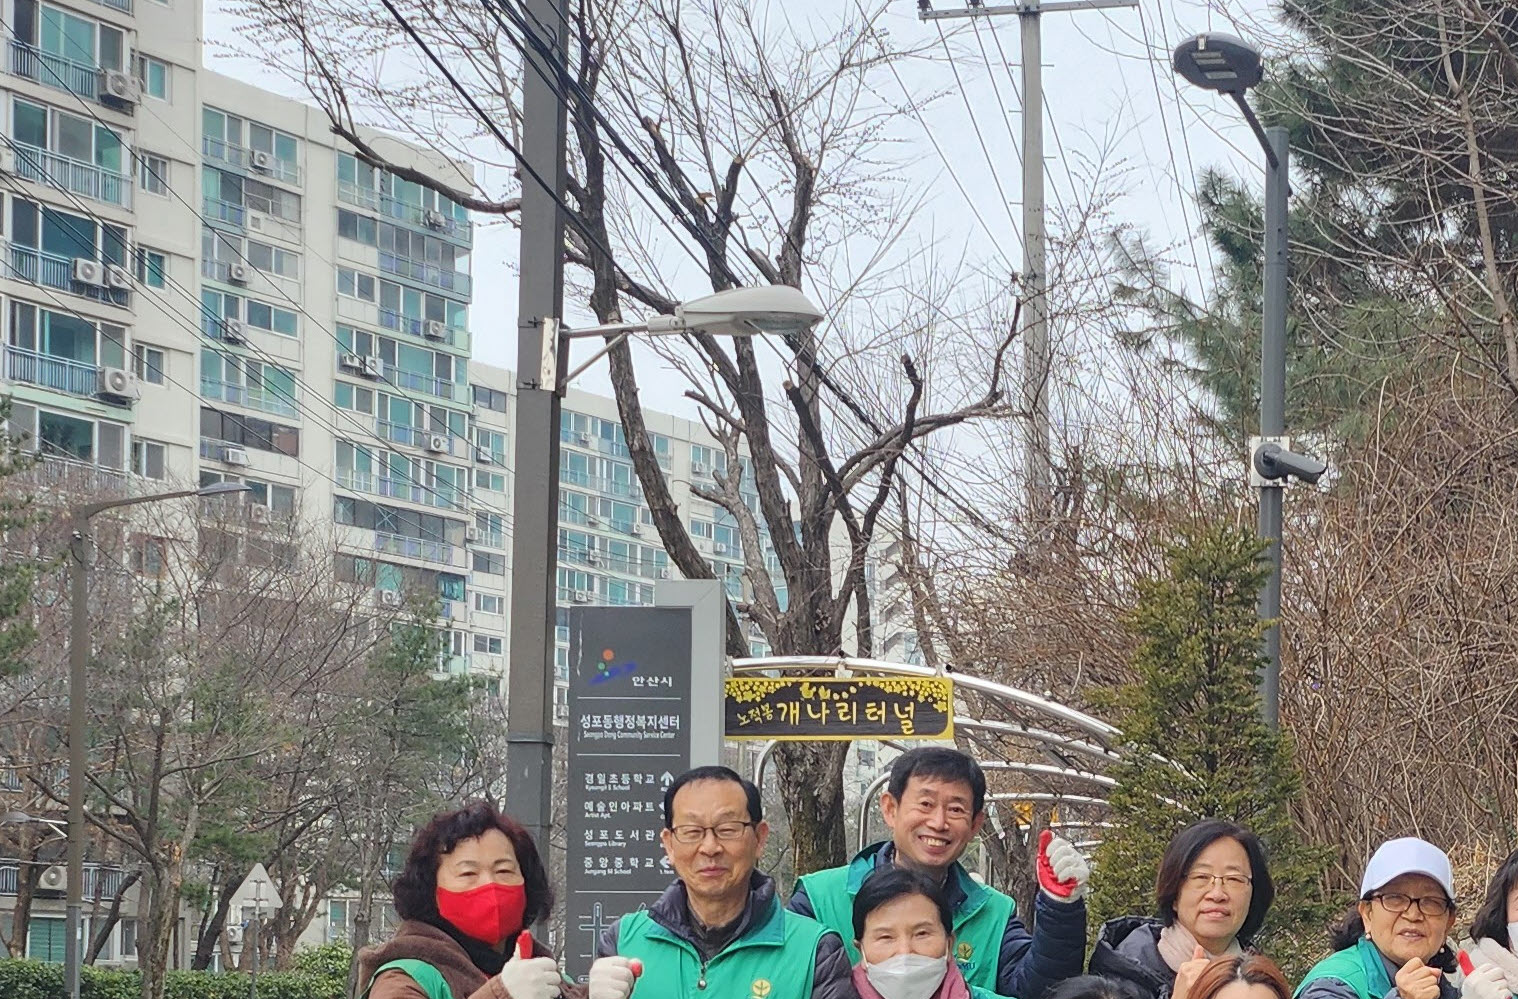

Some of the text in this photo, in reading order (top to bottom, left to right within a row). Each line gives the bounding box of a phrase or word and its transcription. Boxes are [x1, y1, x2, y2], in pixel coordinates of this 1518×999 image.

[631, 675, 673, 688] 안산시
[580, 713, 680, 730] 성포동행정복지센터
[736, 700, 915, 735] 노적봉 개나리터널
[617, 730, 642, 740] Community
[643, 730, 659, 739] Service
[660, 730, 675, 739] Center
[585, 773, 655, 785] 경일초등학교
[584, 801, 655, 813] 예술인아파트
[584, 829, 655, 841] 성포도서관
[608, 840, 626, 848] Library
[584, 856, 655, 868] 중앙중학교
